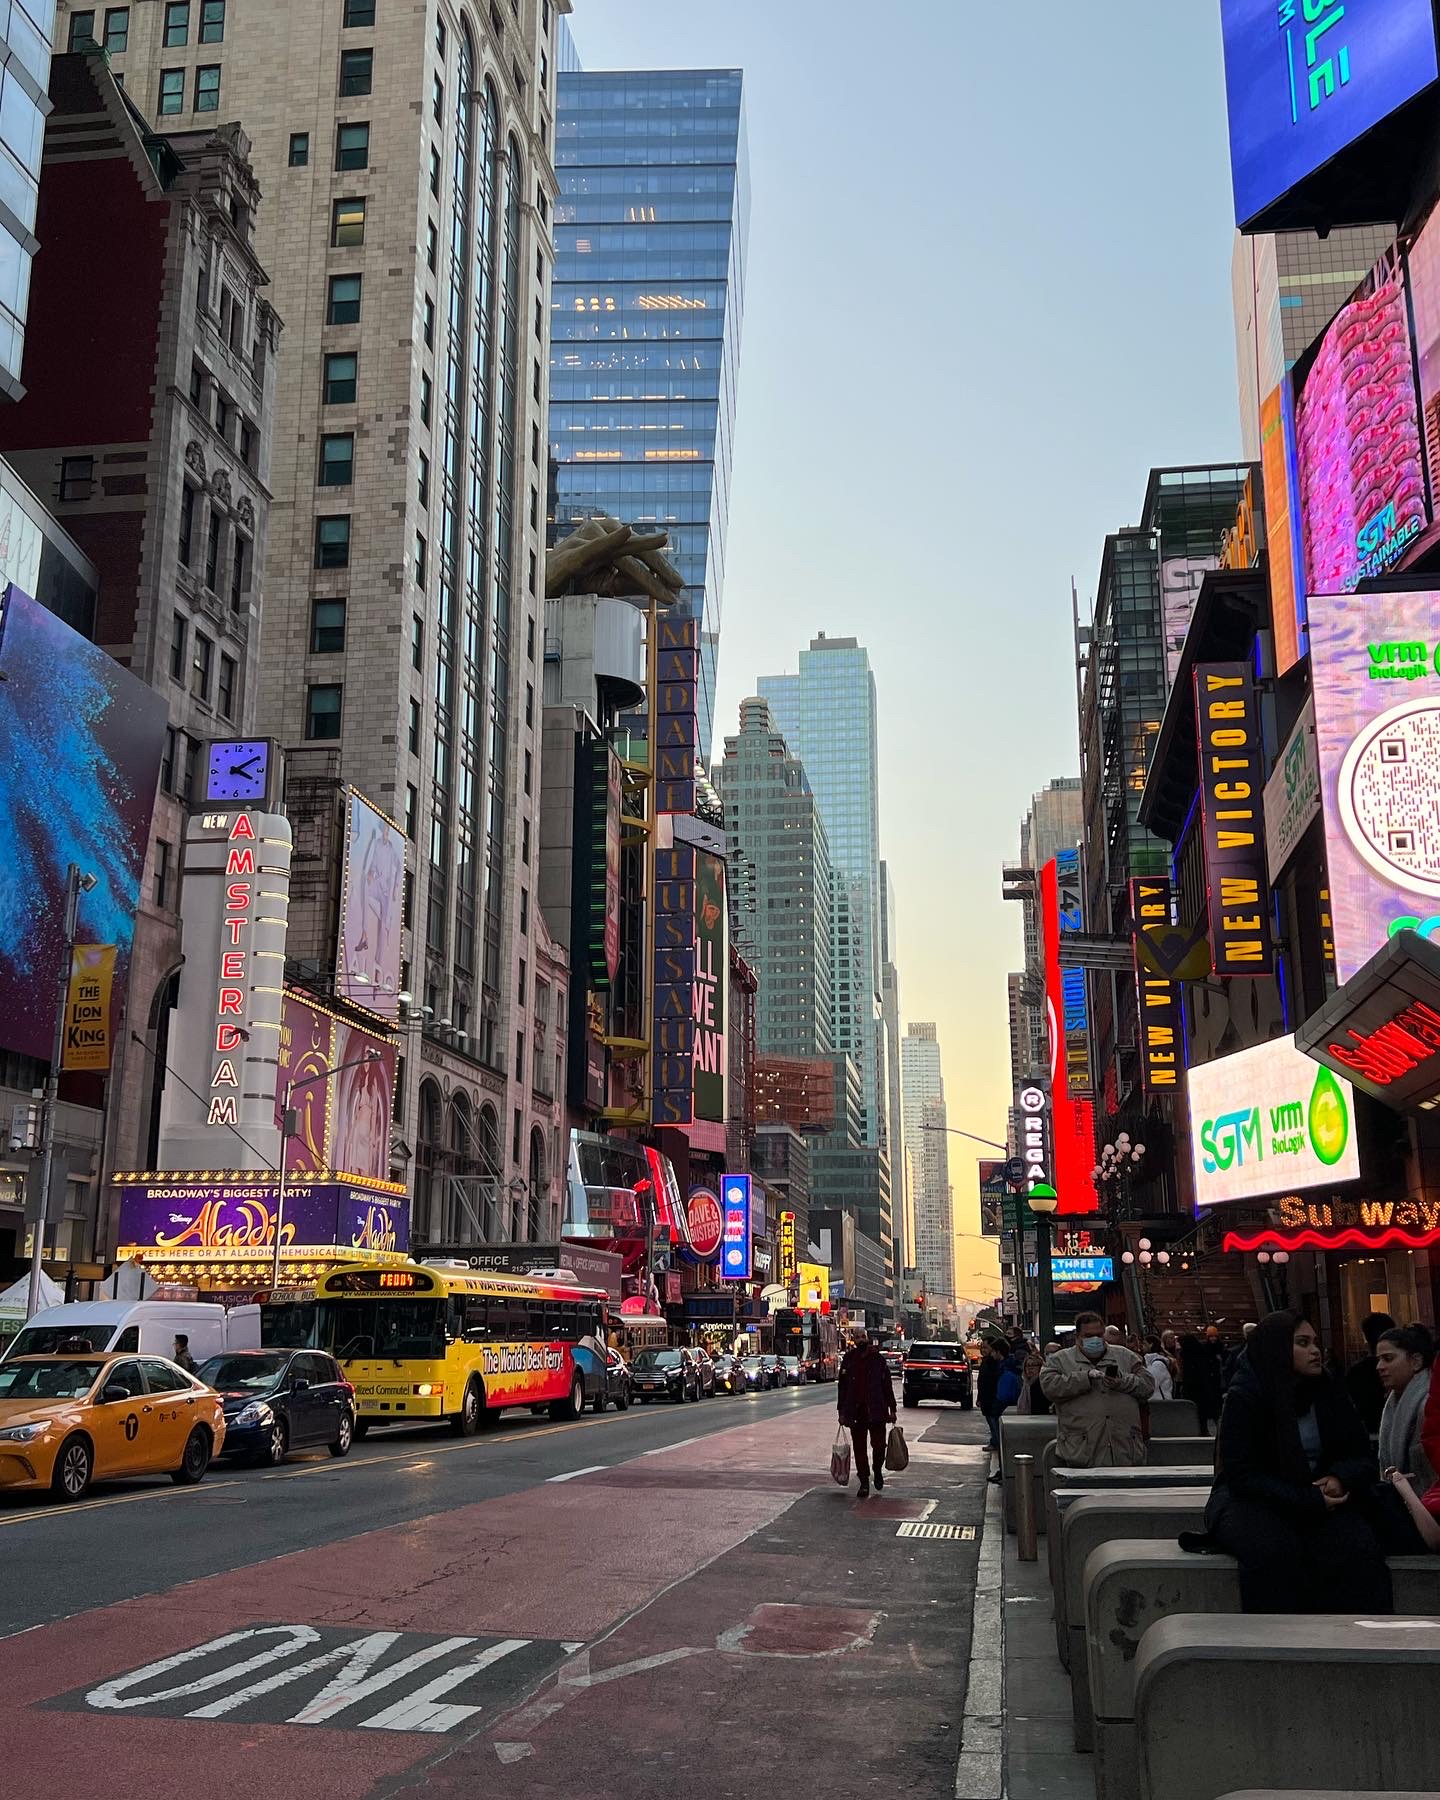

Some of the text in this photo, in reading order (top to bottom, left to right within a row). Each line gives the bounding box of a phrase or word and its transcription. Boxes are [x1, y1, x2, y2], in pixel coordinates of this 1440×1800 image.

[1357, 501, 1396, 560] SGTM
[1345, 517, 1419, 592] SUSTAINABLE
[662, 622, 690, 810] MADAME
[234, 745, 244, 753] 12
[232, 789, 239, 798] 6
[202, 814, 228, 829] NEW
[1206, 674, 1264, 962] NEW VICTORY
[1056, 849, 1080, 888] NEW
[206, 813, 256, 1127] AMSTERDAM
[695, 936, 718, 983] LL
[79, 986, 100, 998] THE
[660, 850, 687, 1122] TUSSAUDS
[1062, 965, 1088, 1032] TUDIOS
[1139, 885, 1177, 1085] NEW VIRY
[693, 1028, 724, 1076] ANT
[1201, 1106, 1263, 1174] SGTM
[147, 1188, 312, 1199] BROADWAY'S BIGGEST PARTY!
[688, 1203, 719, 1227] DAVE &
[155, 1199, 296, 1248] Aladdin
[168, 1213, 192, 1224] Disney
[351, 1206, 396, 1251] Aladdin
[169, 1249, 194, 1257] HERE
[199, 1249, 211, 1257] OR
[215, 1249, 227, 1257] AT
[470, 1256, 509, 1266] OFFICE
[1056, 1259, 1095, 1269] THREE
[483, 1344, 564, 1374] The World's Best Ferry!
[86, 1624, 586, 1733] ONL
